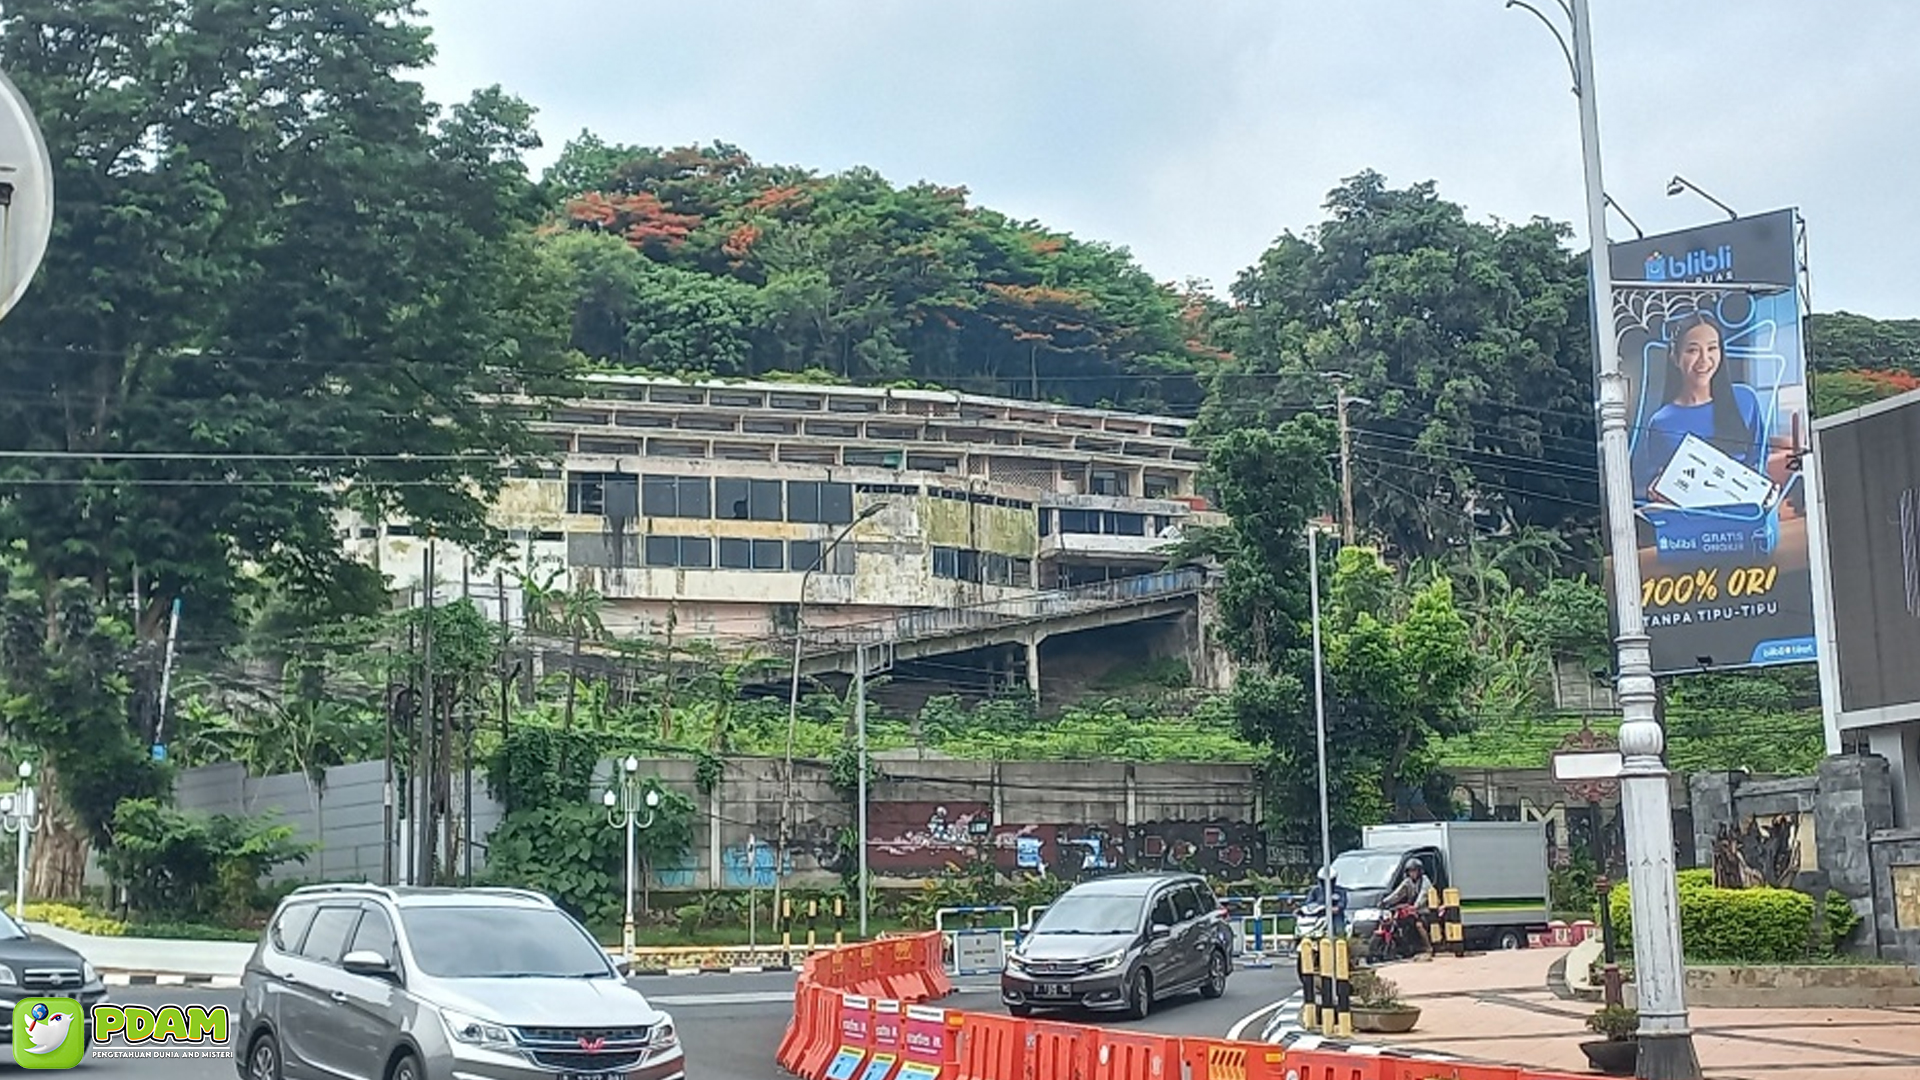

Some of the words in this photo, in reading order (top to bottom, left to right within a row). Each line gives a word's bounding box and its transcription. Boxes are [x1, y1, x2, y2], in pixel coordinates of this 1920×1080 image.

[1669, 245, 1731, 278] blibli
[1701, 532, 1744, 543] GRATIS
[1642, 568, 1718, 607] 100%
[1727, 566, 1777, 597] ORI
[1642, 611, 1692, 627] TANPA
[1697, 602, 1777, 621] TIPU-TIPU
